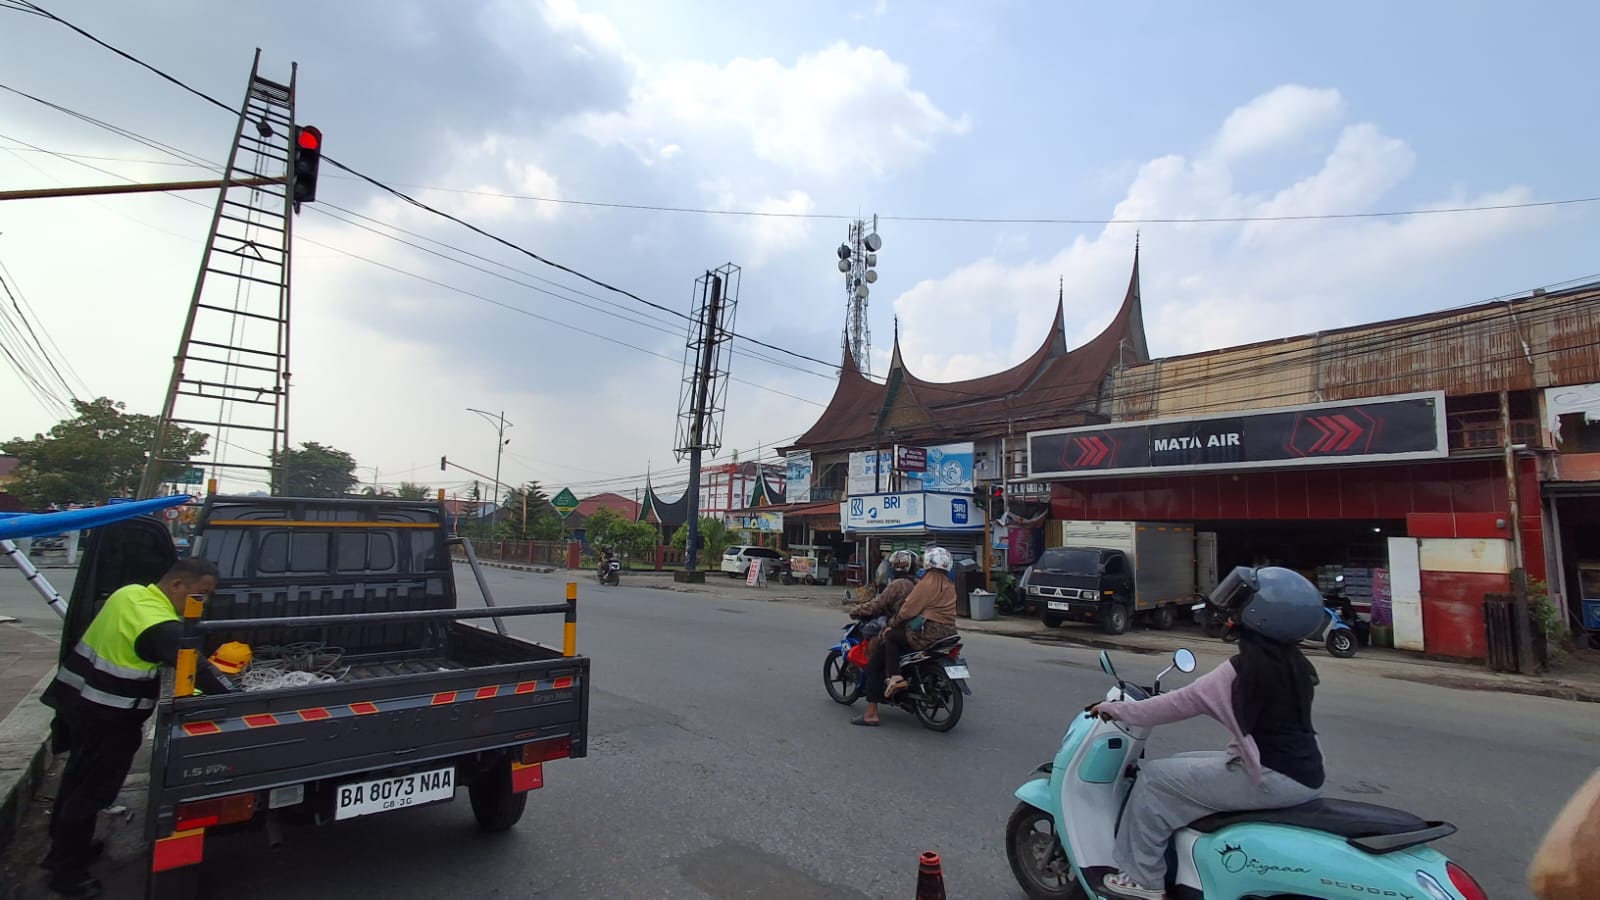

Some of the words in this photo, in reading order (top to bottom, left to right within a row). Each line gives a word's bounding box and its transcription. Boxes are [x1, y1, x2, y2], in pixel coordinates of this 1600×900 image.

[1154, 436, 1202, 452] MATA
[1207, 433, 1240, 448] AIR
[883, 496, 901, 509] BRI
[341, 786, 364, 808] BA
[370, 777, 415, 802] 8073
[420, 770, 451, 793] NAA
